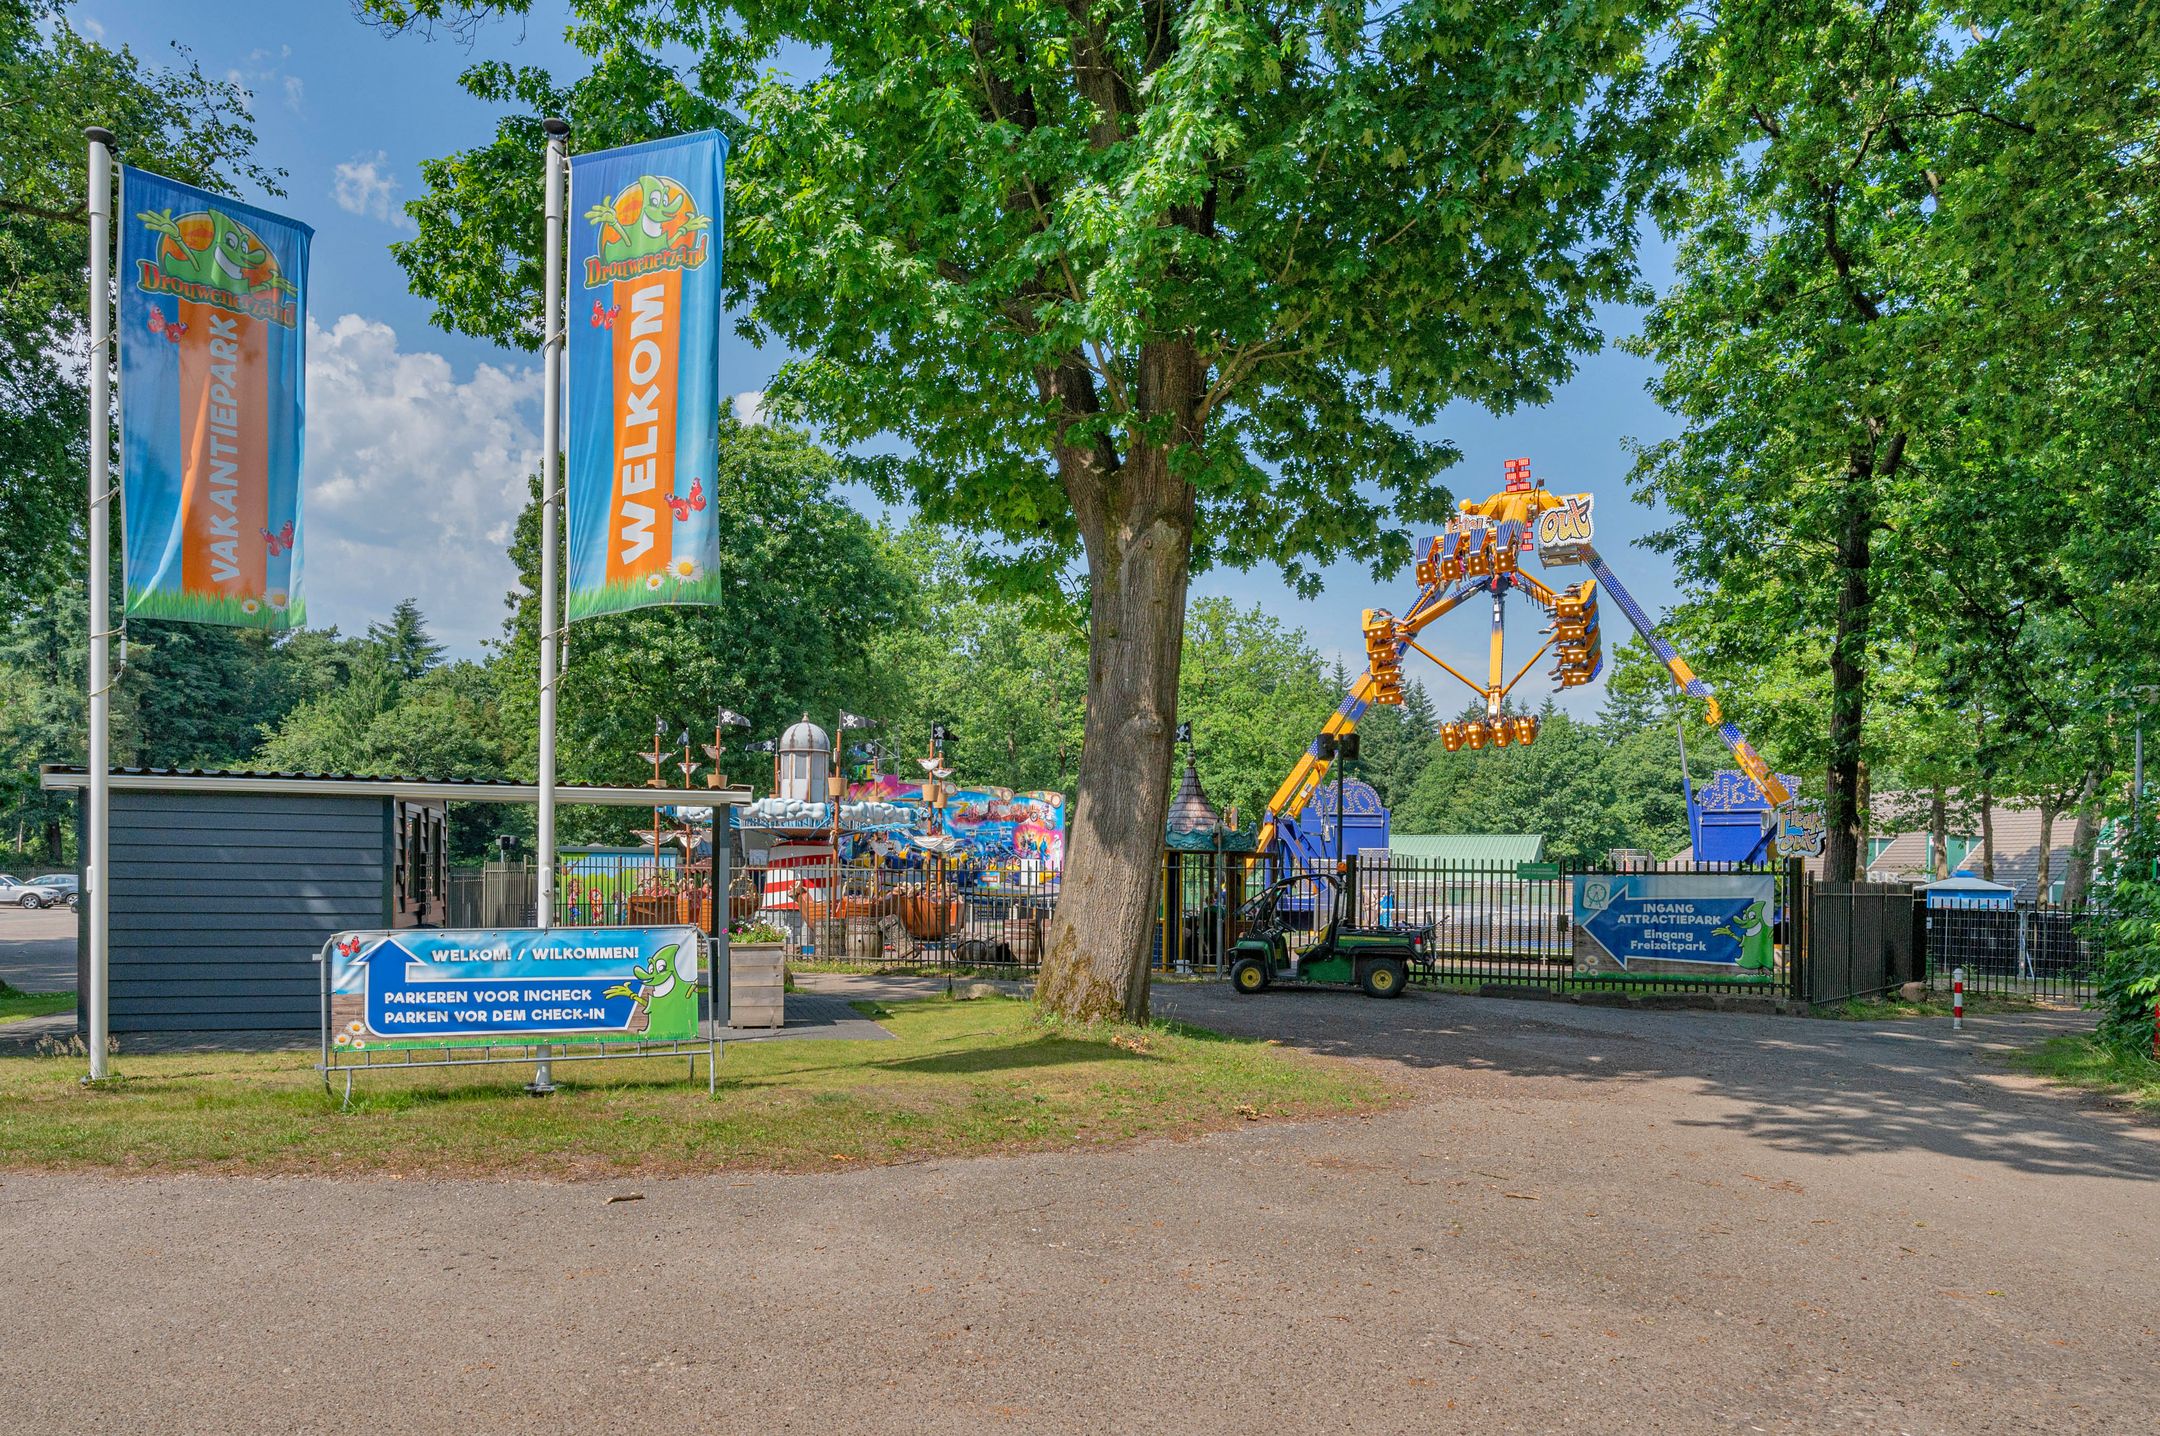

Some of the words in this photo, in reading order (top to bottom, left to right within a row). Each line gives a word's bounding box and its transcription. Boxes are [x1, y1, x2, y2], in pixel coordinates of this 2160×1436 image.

[587, 236, 706, 285] Drouwenerzand
[620, 283, 665, 566] WELKOM
[210, 314, 240, 583] VAKANTIEPARK
[1643, 903, 1695, 913] INGANG
[1617, 914, 1722, 925] ATTRACTIEPARK
[1644, 929, 1694, 942] Eingang
[1630, 940, 1707, 953] Freizeitpark
[431, 949, 512, 962] WELKOM!
[384, 991, 468, 1004] PARKEREN
[473, 989, 519, 1003] VOOR
[523, 988, 592, 1002] INCHECK
[384, 1011, 449, 1024] PARKEN
[453, 1010, 488, 1022] VOR
[492, 1009, 526, 1021] DEM
[531, 1007, 606, 1021] CHECK-IN
